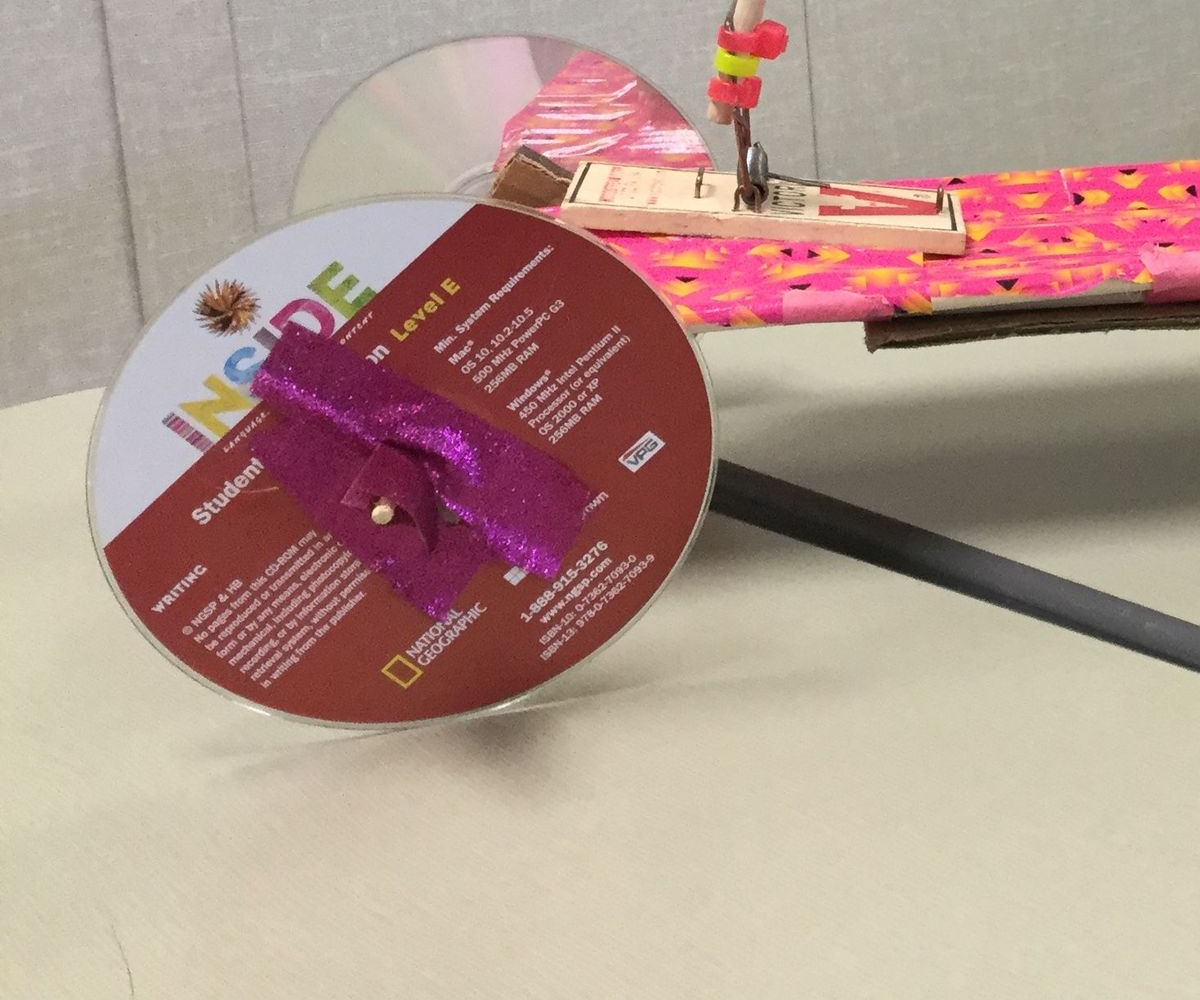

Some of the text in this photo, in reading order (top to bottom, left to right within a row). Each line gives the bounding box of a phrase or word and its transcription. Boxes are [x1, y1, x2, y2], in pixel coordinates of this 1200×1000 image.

[338, 310, 376, 345] ONTENT
[433, 243, 554, 353] Min. System Requirements:
[459, 306, 534, 374] OS 10, 10.2-10.5
[471, 298, 565, 384] 500 MHz PowerPC G3
[483, 341, 540, 393] 256MB RAM
[189, 276, 461, 526] Student Level E
[516, 400, 539, 420] 450
[535, 382, 558, 402] MHz
[555, 364, 578, 384] Intel
[575, 331, 614, 366] Pentium
[527, 333, 632, 428] Processor (or equivalent)
[537, 377, 602, 436] OS 2000 or XP
[547, 393, 603, 444] 256MB RAM
[626, 438, 659, 468] VPG
[150, 562, 208, 615] WRITING
[190, 599, 220, 627] NGSP
[225, 577, 244, 594] HB
[192, 629, 208, 643] No
[205, 607, 233, 632] pages
[229, 588, 252, 609] from
[248, 574, 268, 591] this
[263, 543, 300, 577] CD-ROM
[296, 528, 318, 548] may
[203, 548, 315, 651] be reproduced or transmitted
[214, 638, 238, 659] form
[235, 629, 248, 640] or
[244, 619, 259, 633] by
[255, 606, 274, 623] any
[297, 543, 338, 582] electronic
[271, 588, 311, 624] including
[275, 627, 288, 639] or
[284, 616, 299, 630] by
[294, 577, 342, 620] information
[518, 539, 609, 623] 1-888-915-3276
[538, 553, 638, 645] ISBN-10: 0-7362-7093-0
[539, 556, 614, 625] www.ngsp.com
[247, 649, 283, 681] retrieval
[309, 595, 341, 624] without
[259, 677, 272, 688] in
[267, 652, 299, 681] writing
[293, 634, 317, 655] from
[313, 622, 331, 638] the
[415, 600, 488, 667] GEOGRAPHIC
[539, 625, 578, 661] ISBN-13:
